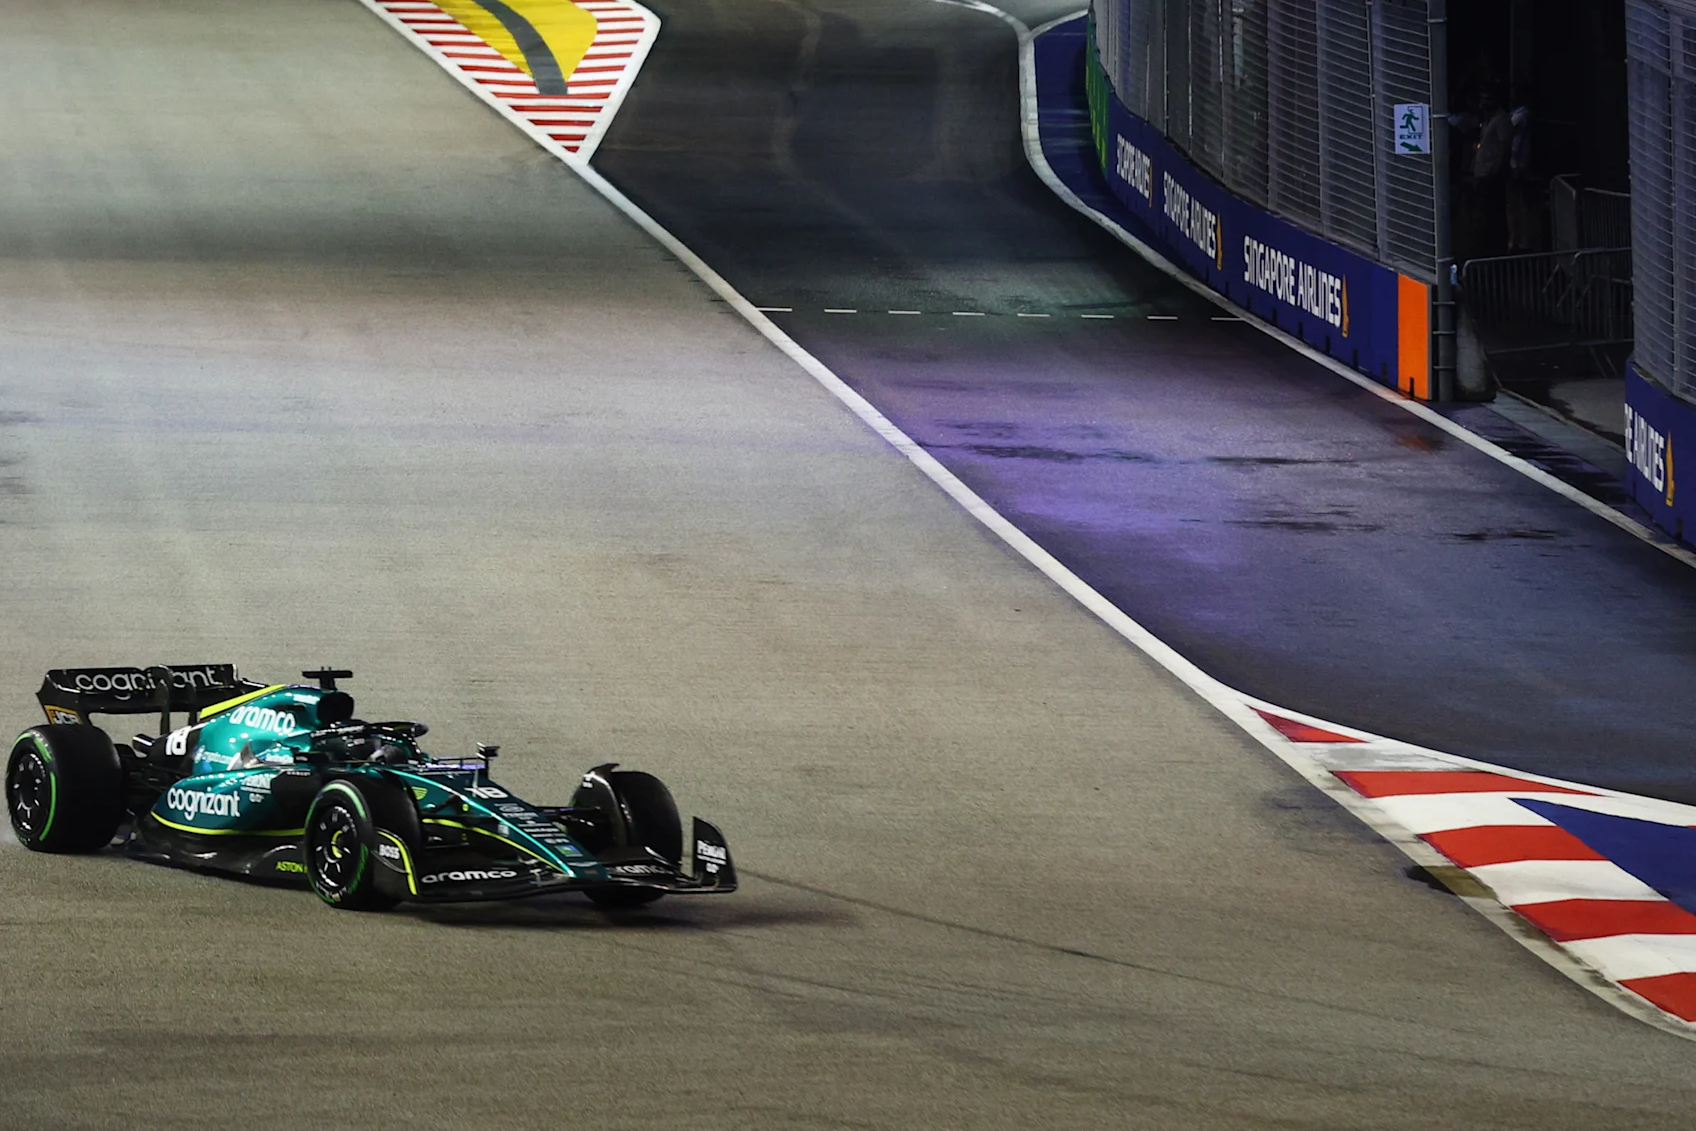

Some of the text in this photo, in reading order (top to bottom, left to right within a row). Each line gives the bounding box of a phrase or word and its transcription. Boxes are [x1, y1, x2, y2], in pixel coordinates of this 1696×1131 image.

[1244, 235, 1341, 327] SINGAPORE AIRLINES
[75, 667, 222, 700] cogniant
[229, 706, 296, 733] aramco
[166, 726, 192, 756] 18
[167, 787, 240, 821] cognizant
[379, 844, 401, 860] BOSS
[421, 870, 518, 884] aramco
